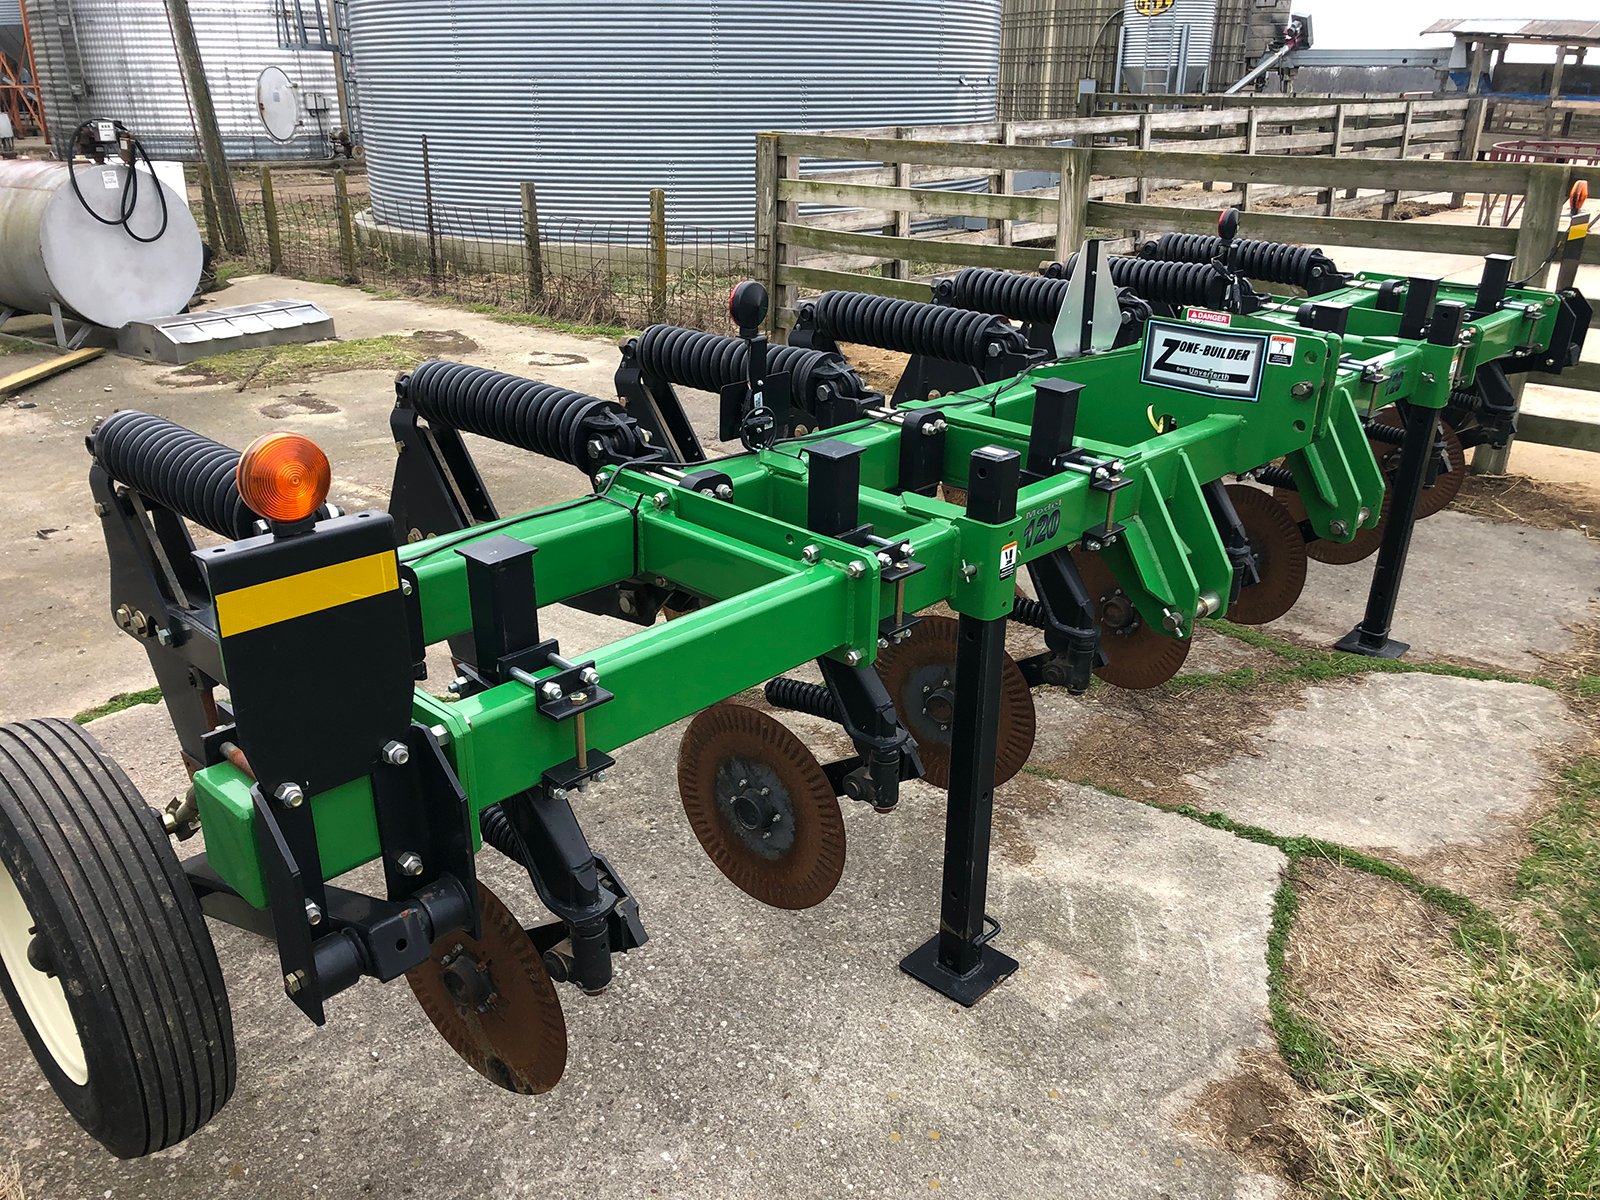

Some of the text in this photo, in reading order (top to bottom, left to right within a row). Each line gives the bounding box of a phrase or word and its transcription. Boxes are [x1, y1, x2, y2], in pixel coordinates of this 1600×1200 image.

[1197, 311, 1227, 323] DANGER
[1152, 338, 1251, 370] ZONE-BUILDER
[1026, 498, 1062, 520] Model
[1023, 509, 1061, 549] 120
